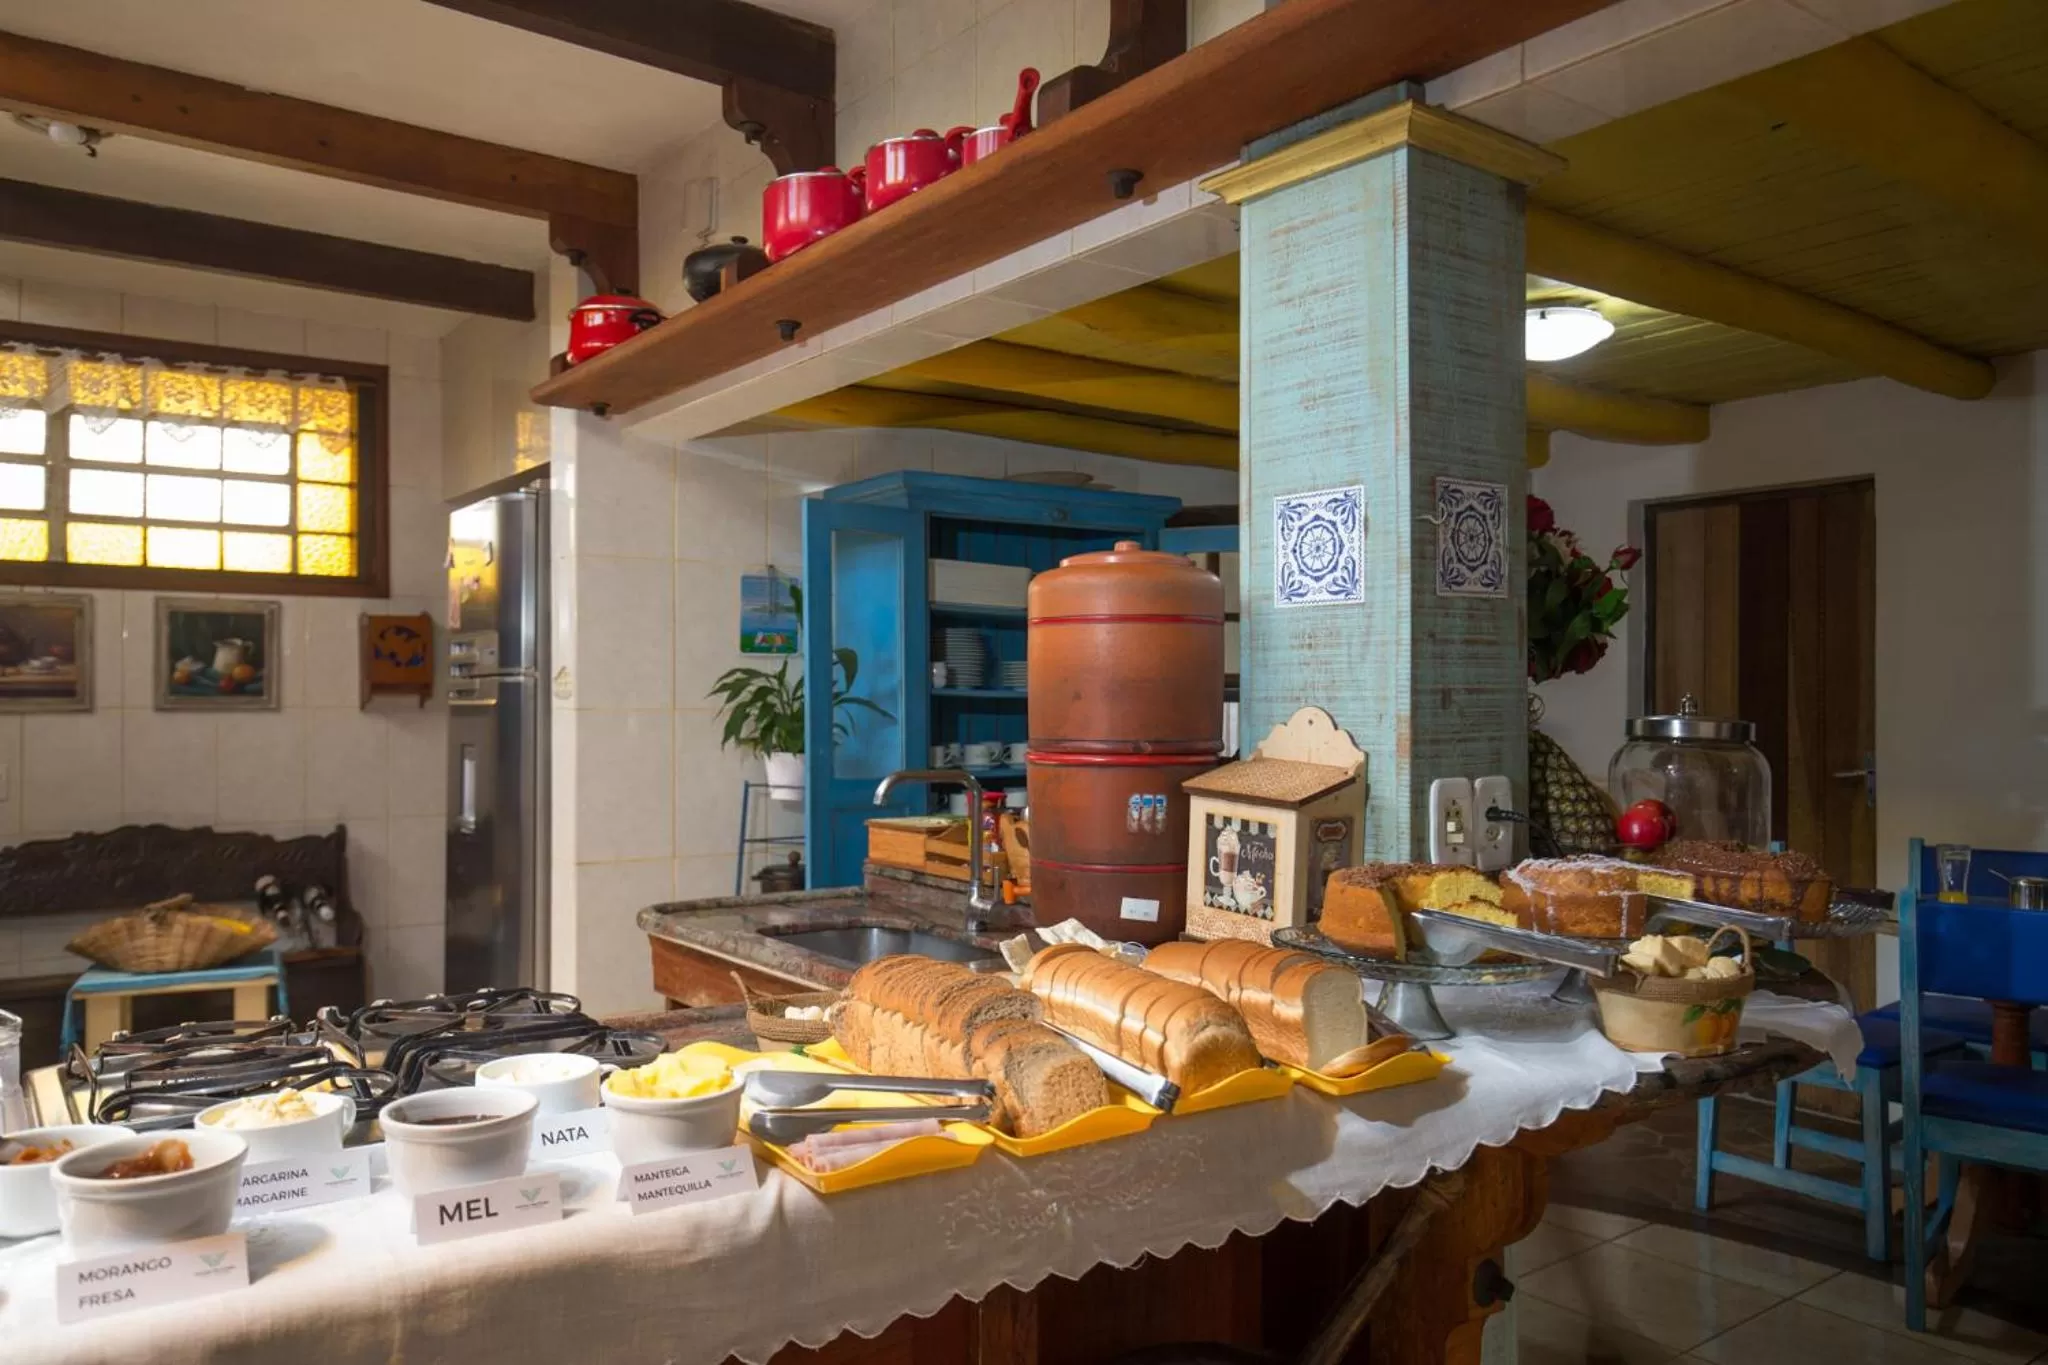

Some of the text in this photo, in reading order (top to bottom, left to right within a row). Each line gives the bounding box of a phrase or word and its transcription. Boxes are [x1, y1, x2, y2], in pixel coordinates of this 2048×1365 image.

[541, 1126, 589, 1146] NATA
[240, 1168, 309, 1187] ARGARINA
[634, 1165, 690, 1183] MANTEIGA
[637, 1179, 712, 1201] MANTEQUILLA
[439, 1197, 499, 1225] MEL
[77, 1256, 172, 1284] MORANGO
[77, 1288, 135, 1309] FRESA
